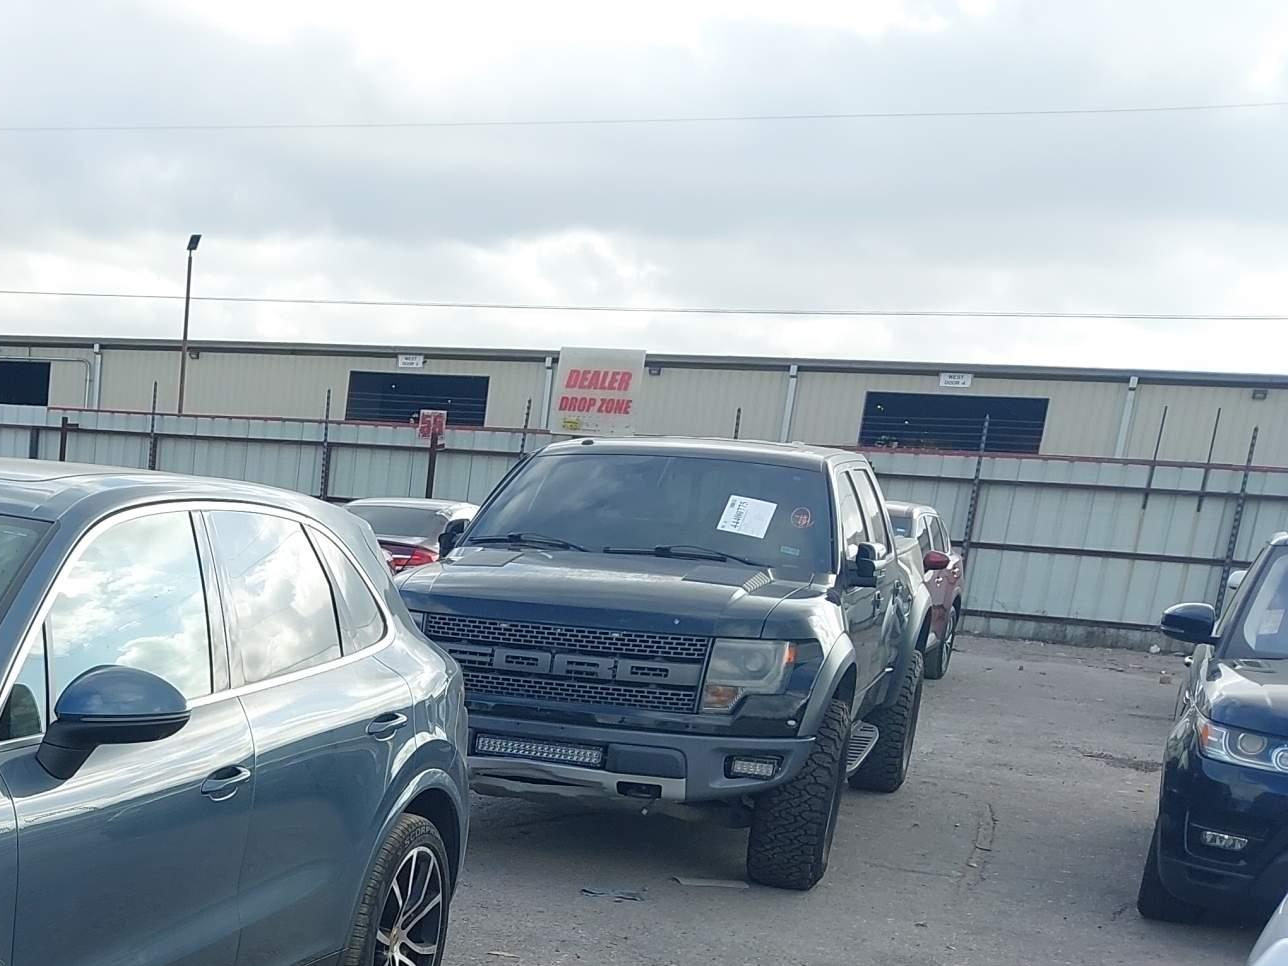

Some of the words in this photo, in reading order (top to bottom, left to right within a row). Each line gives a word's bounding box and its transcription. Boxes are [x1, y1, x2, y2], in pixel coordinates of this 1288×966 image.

[565, 368, 633, 392] DEALER
[558, 396, 596, 413] DROP
[597, 397, 633, 415] ZONE
